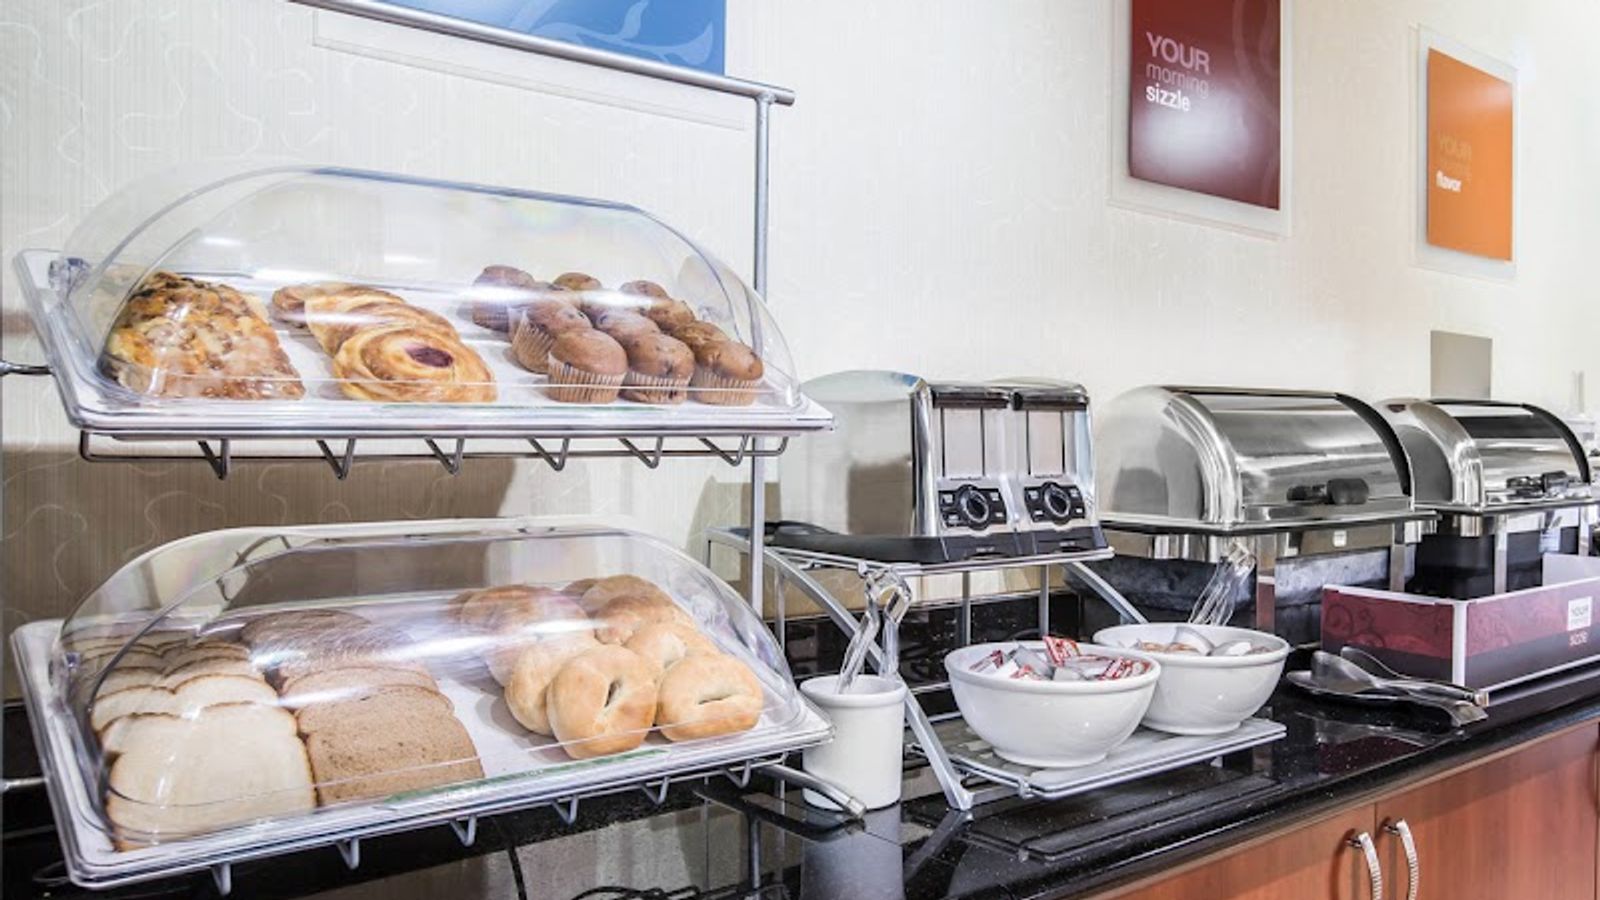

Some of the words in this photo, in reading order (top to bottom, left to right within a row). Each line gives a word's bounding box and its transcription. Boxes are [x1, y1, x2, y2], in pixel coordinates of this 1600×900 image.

[1146, 31, 1210, 75] YOUR
[1146, 63, 1209, 100] morning
[1146, 82, 1191, 112] sizzle
[1436, 170, 1462, 192] flavor
